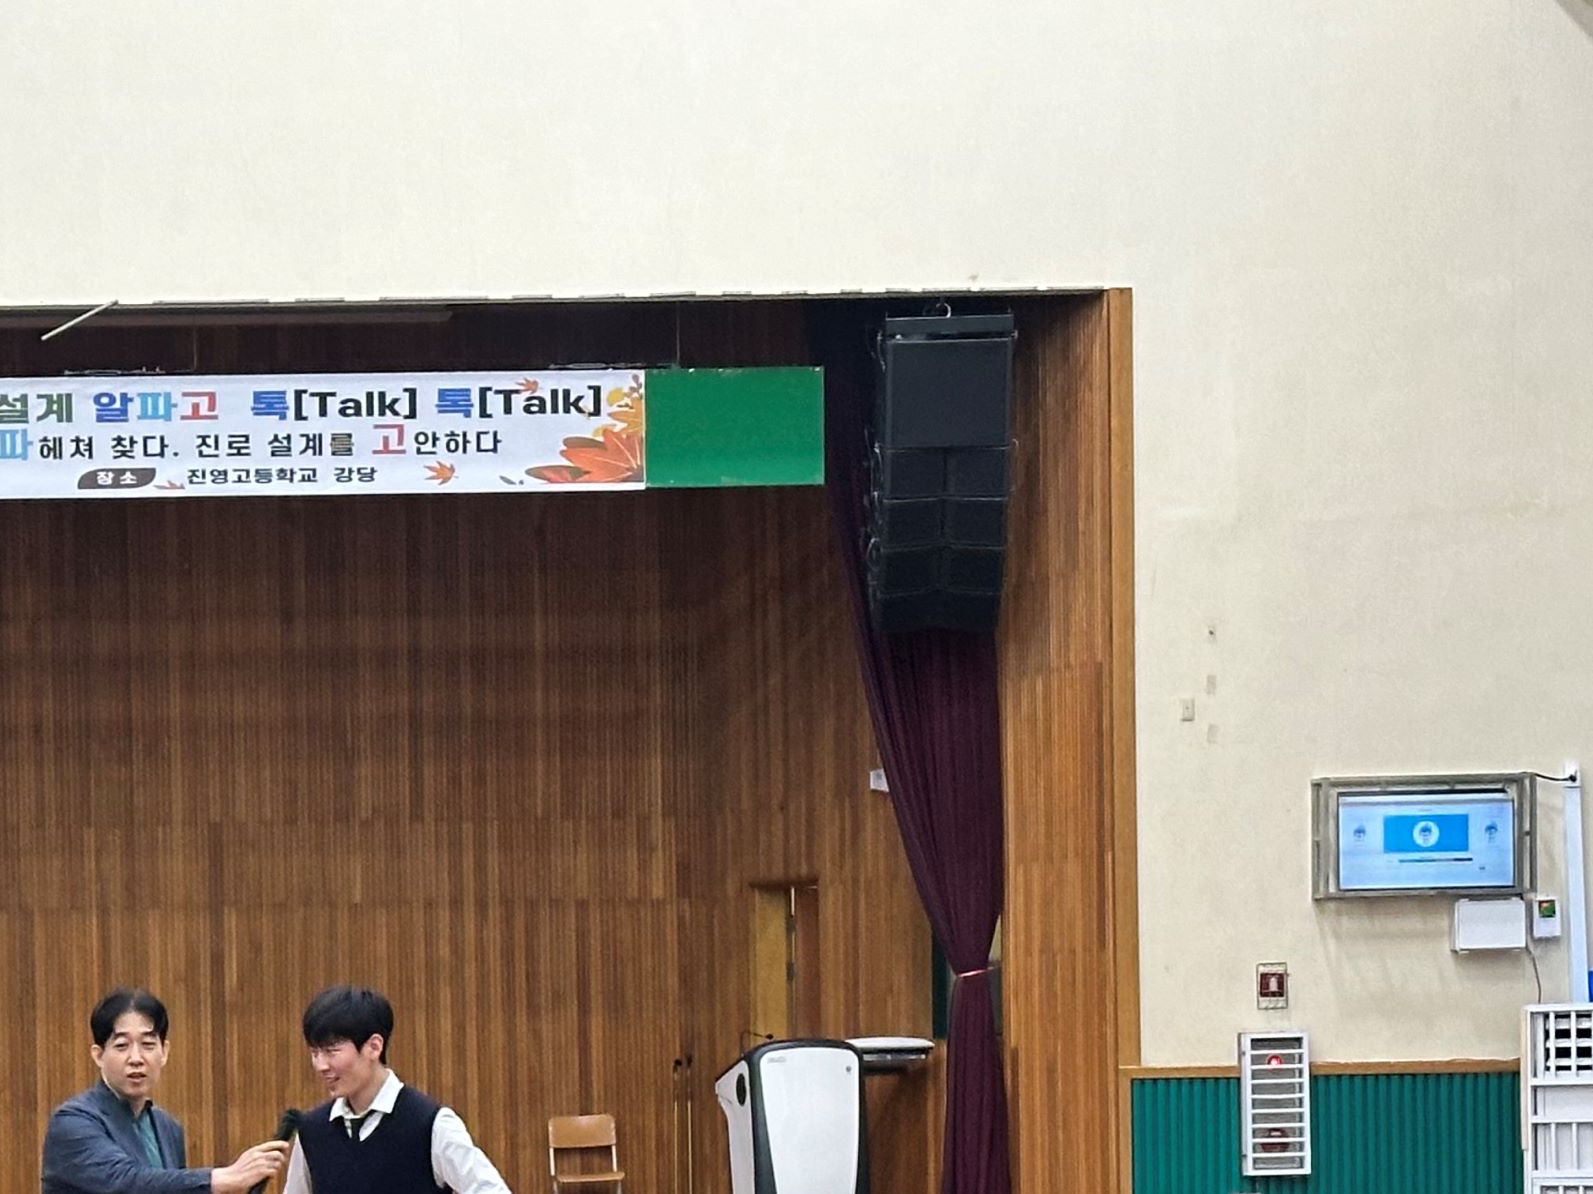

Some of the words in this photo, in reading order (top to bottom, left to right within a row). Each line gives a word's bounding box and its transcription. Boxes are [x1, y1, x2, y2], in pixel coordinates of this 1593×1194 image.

[93, 391, 219, 423] 알파고
[250, 388, 417, 421] 톡[Talk]
[435, 385, 602, 419] 톡[Talk]
[110, 435, 179, 459] 찾다.
[195, 434, 252, 458] 진로
[267, 432, 355, 457] 설계를
[371, 423, 502, 456] 고안하다
[187, 467, 318, 484] 진영고등학교
[333, 466, 378, 483] 강당
